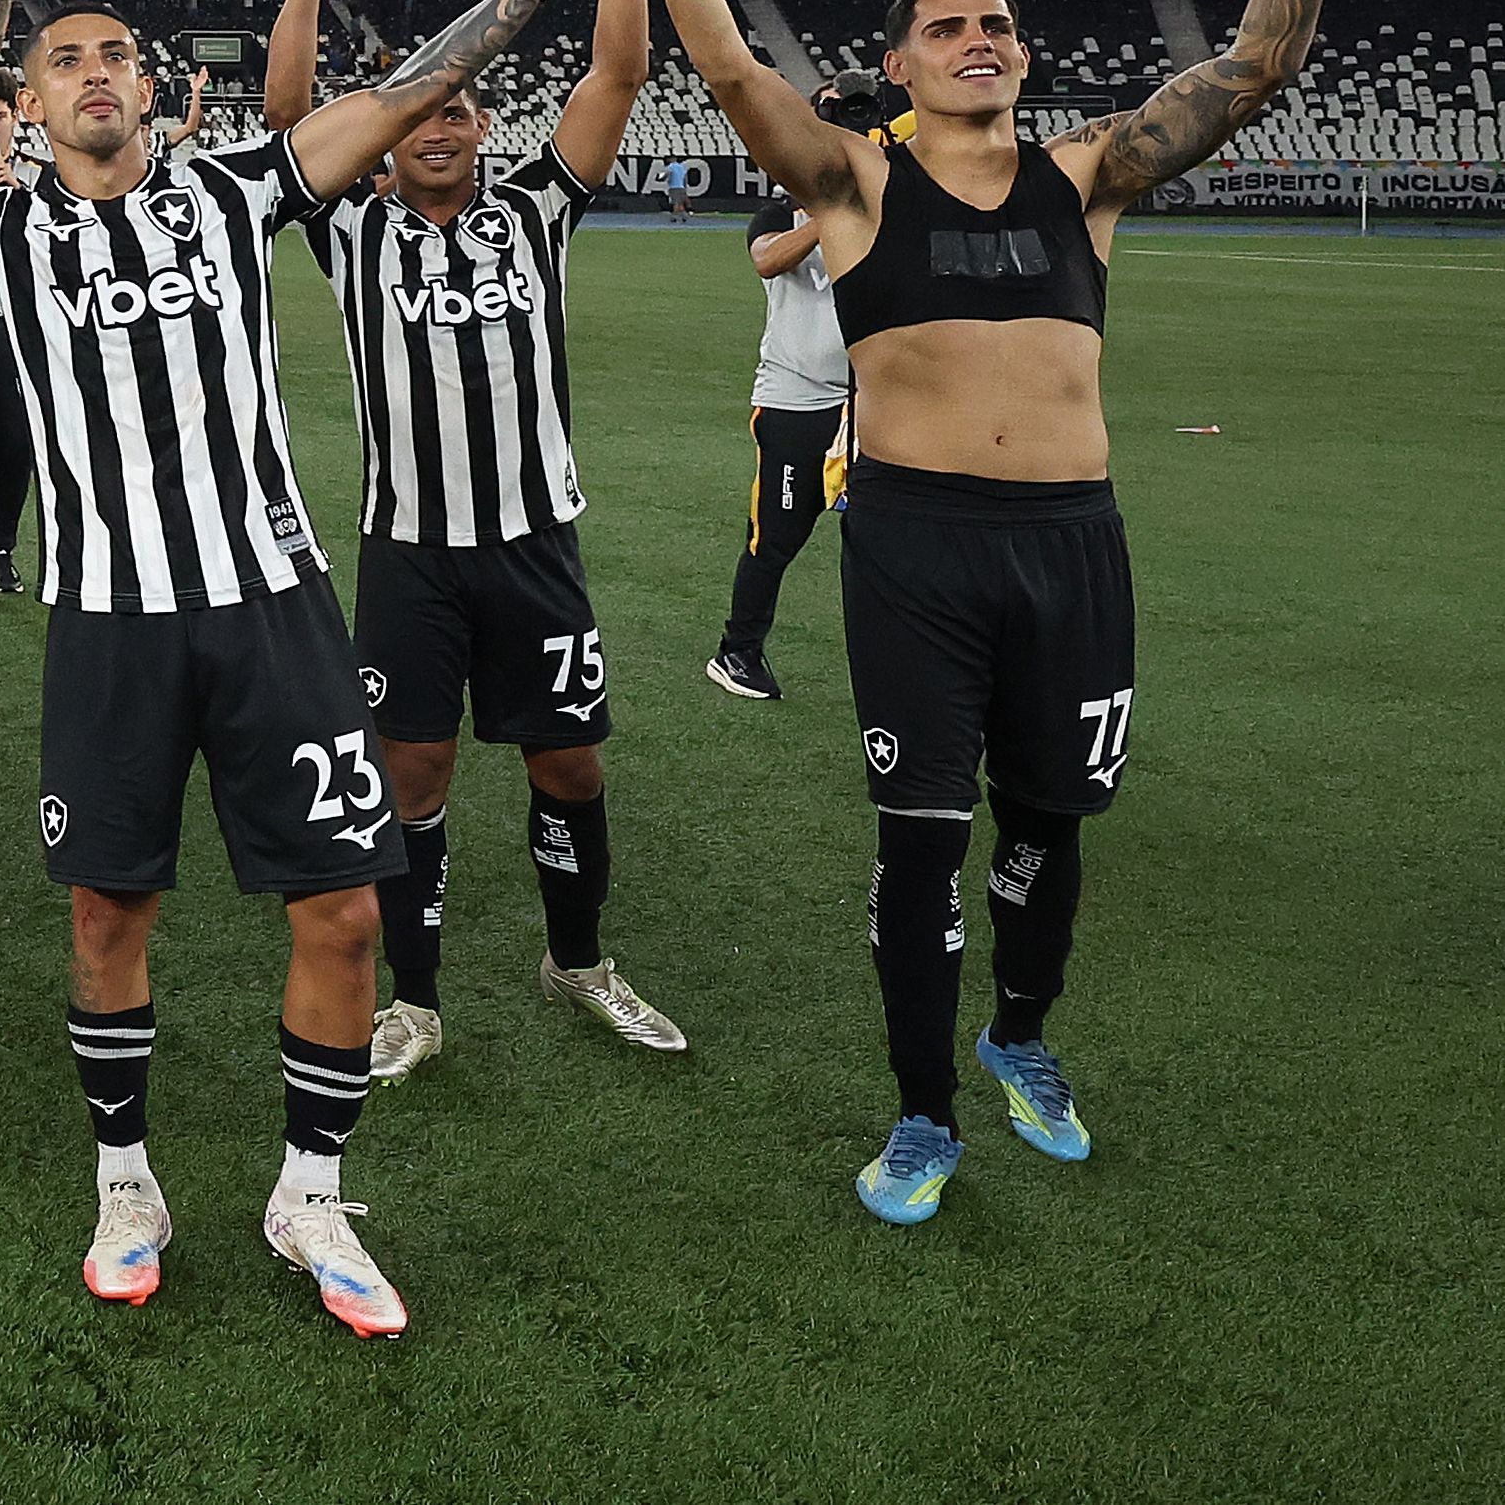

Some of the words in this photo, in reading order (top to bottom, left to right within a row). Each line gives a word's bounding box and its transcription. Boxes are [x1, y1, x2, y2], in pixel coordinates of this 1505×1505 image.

[1208, 173, 1341, 193] RESPEITO
[51, 256, 220, 326] vbet
[393, 269, 532, 323] vbet
[268, 502, 293, 519] 1942
[543, 627, 605, 693] 75
[1080, 688, 1133, 766] 77
[291, 729, 383, 822] 23
